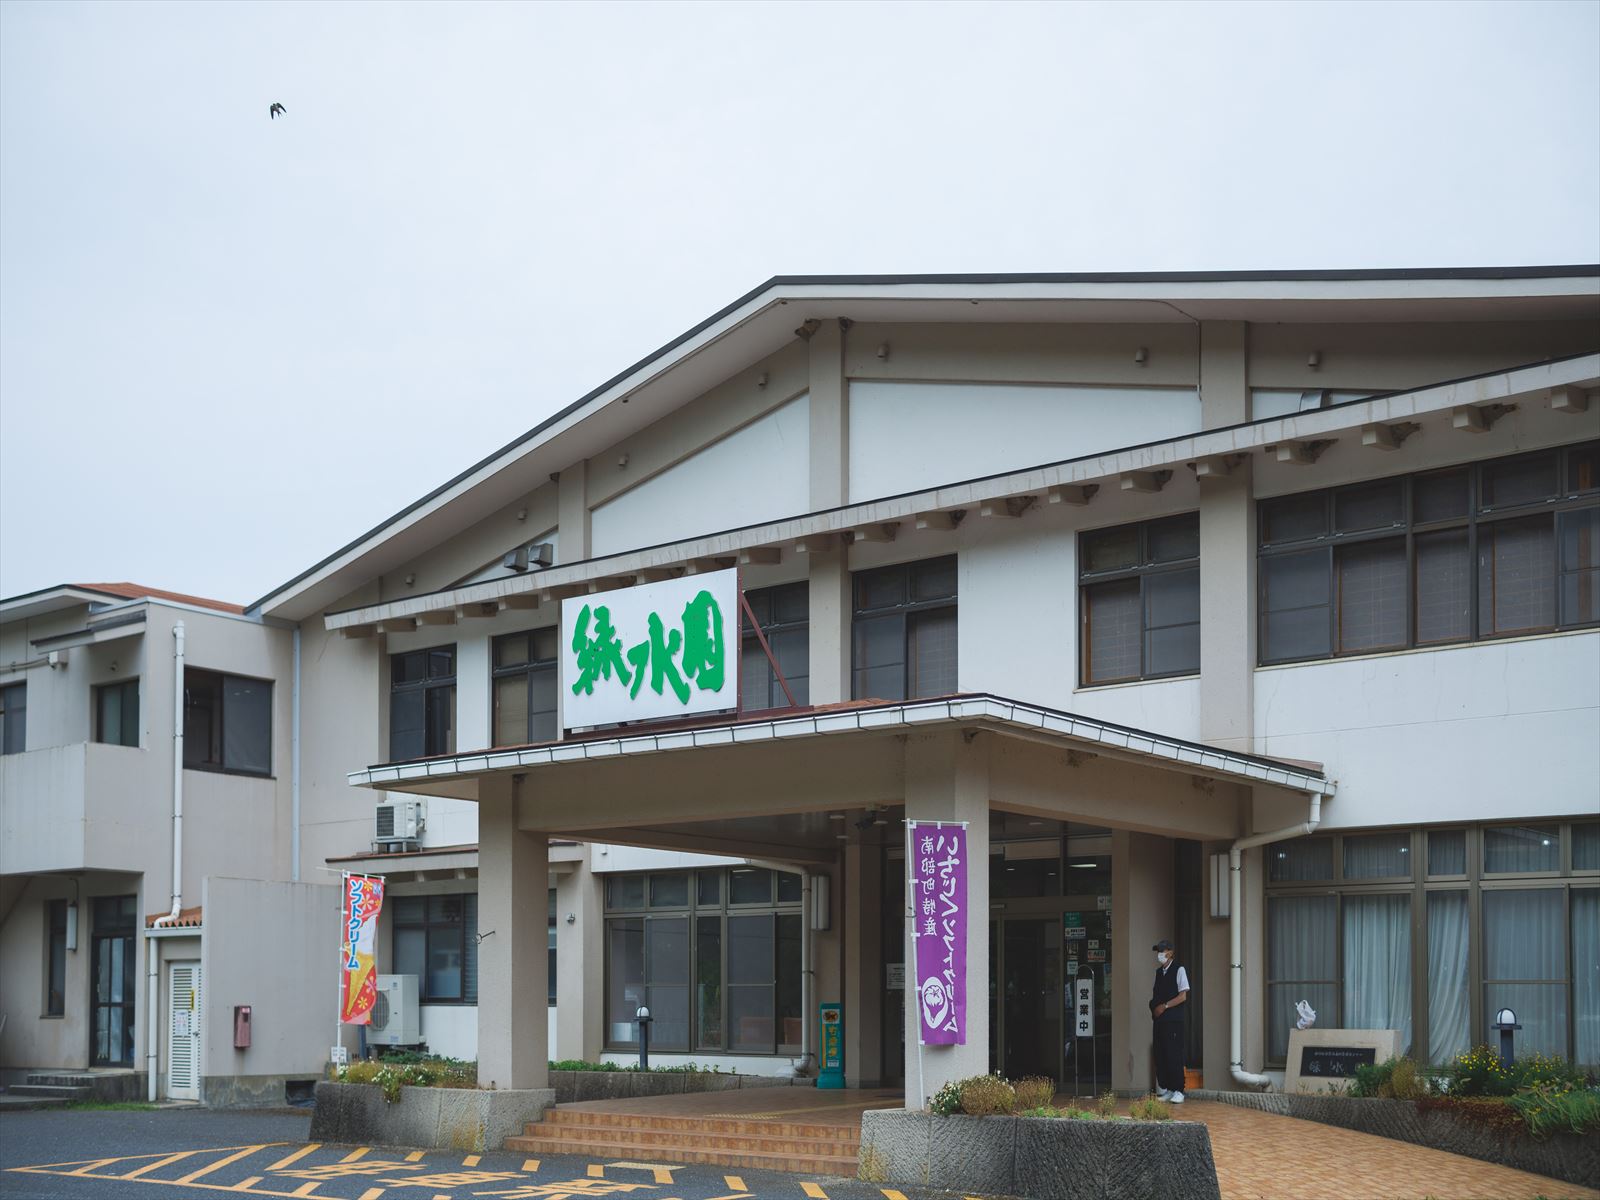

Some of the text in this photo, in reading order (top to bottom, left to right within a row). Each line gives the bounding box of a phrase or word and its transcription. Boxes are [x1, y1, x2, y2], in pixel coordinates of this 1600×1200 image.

[572, 590, 725, 705] 緑水園
[348, 880, 362, 969] ソフトクリーム
[1080, 988, 1089, 1031] 営業中
